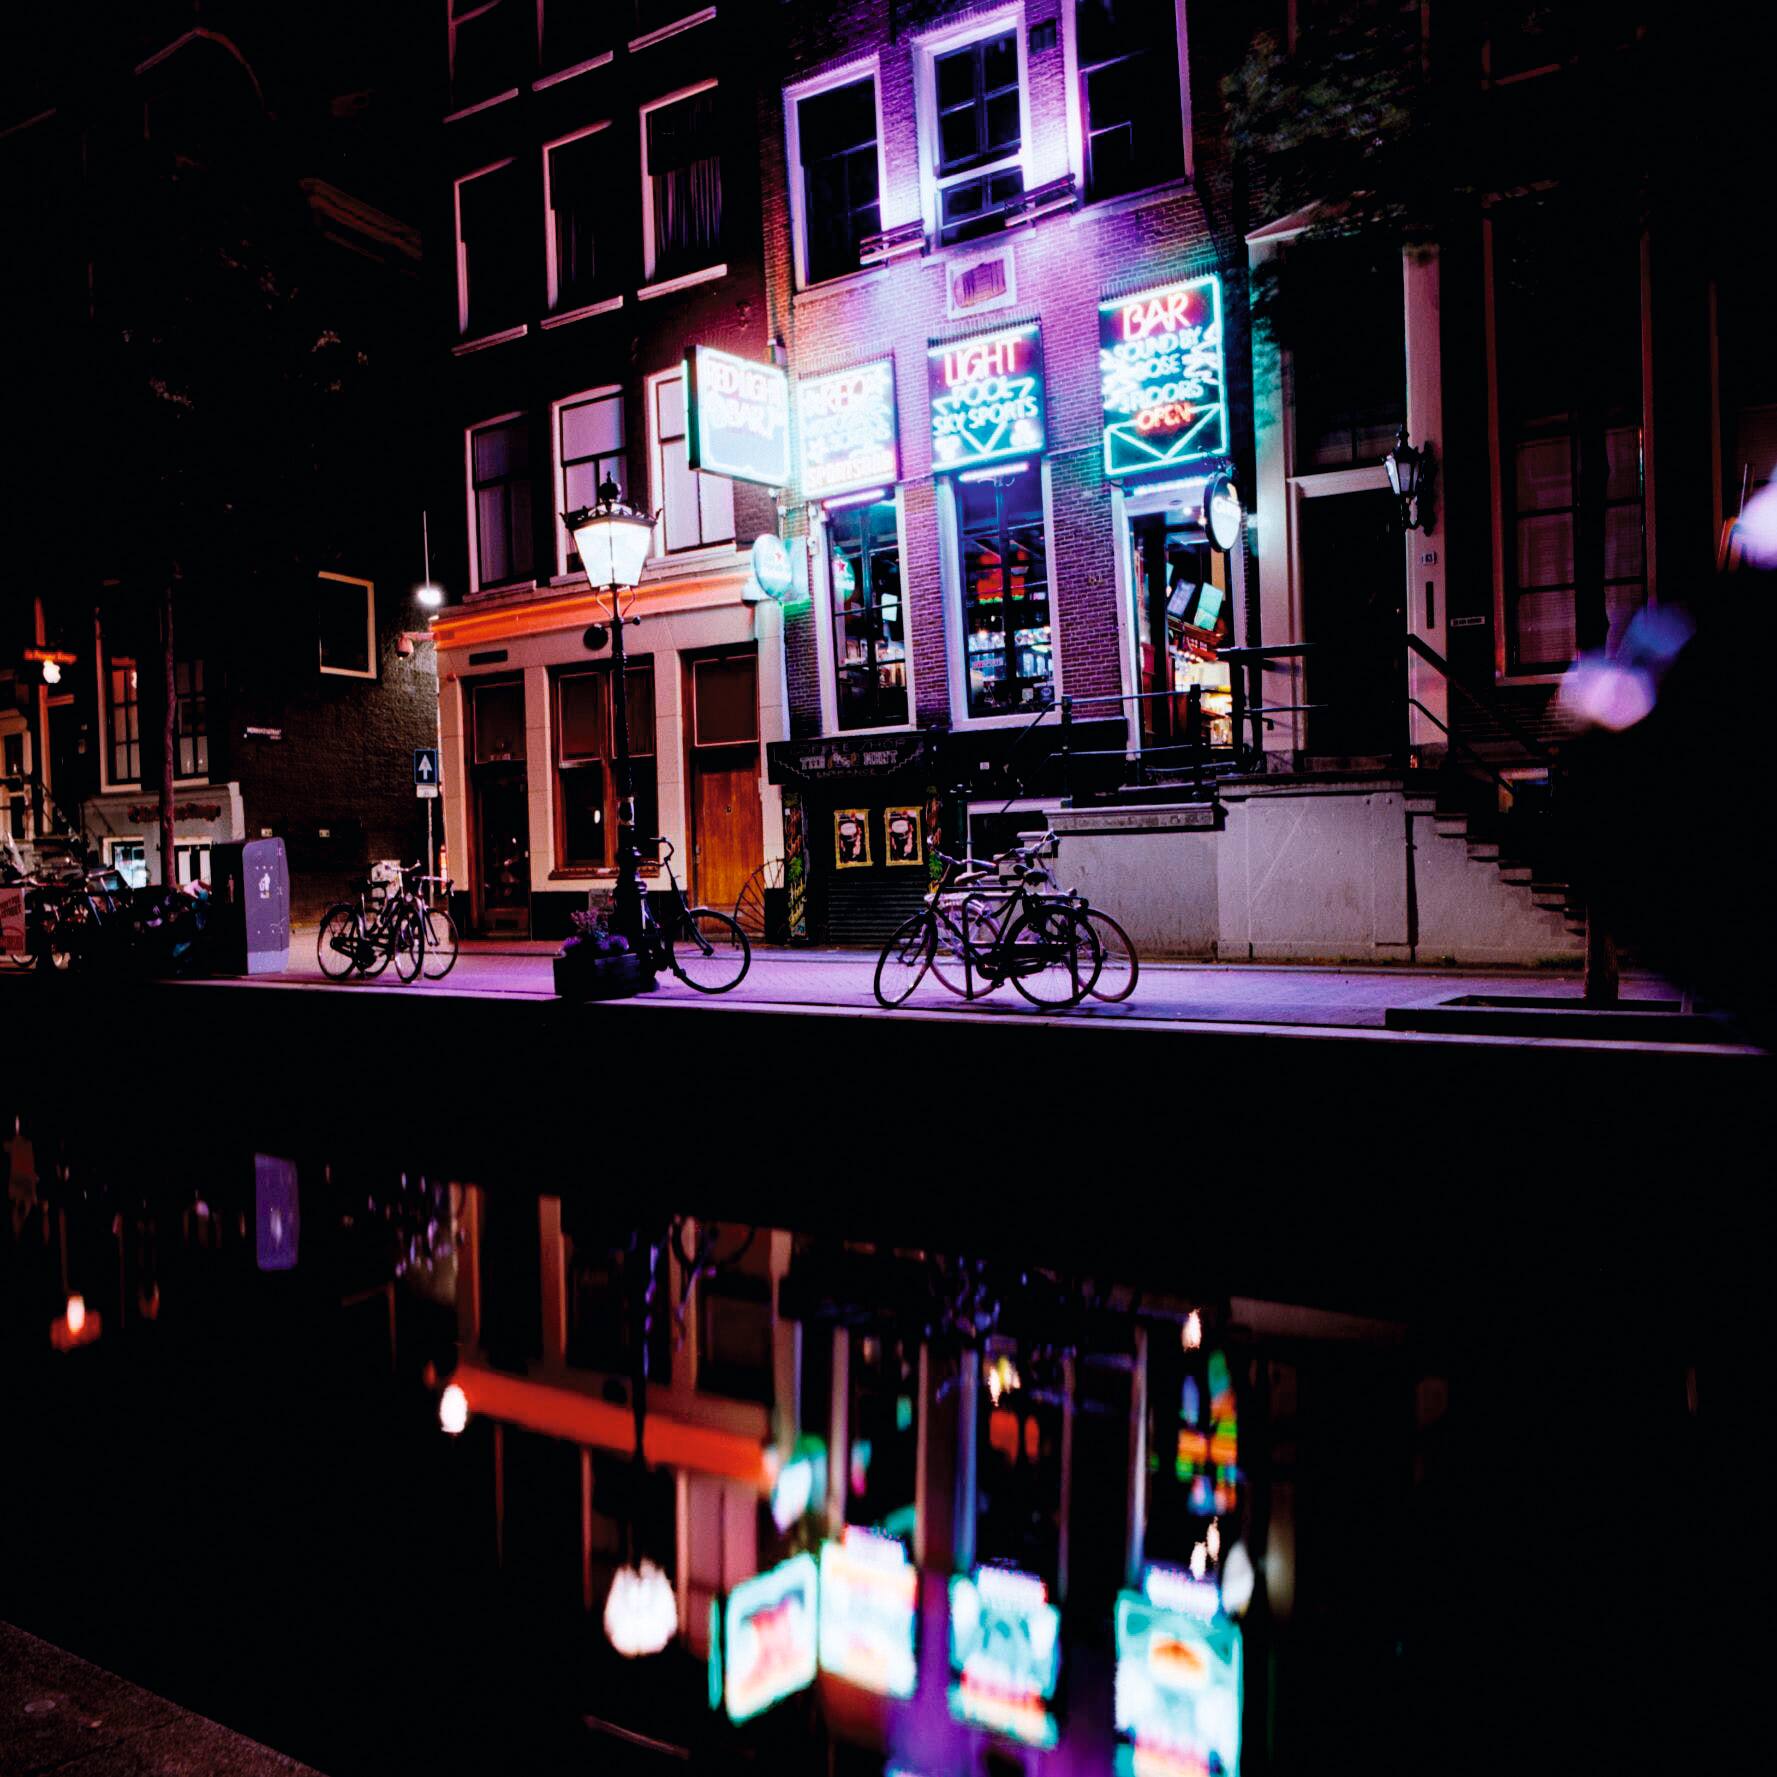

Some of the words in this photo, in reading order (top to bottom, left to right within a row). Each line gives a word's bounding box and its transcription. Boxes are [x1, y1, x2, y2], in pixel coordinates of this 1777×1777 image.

[1122, 294, 1190, 340] BAR
[944, 338, 1022, 385] LIGHT
[1113, 332, 1179, 361] SOUND
[1178, 325, 1203, 350] BY
[951, 375, 1014, 409] POOL
[932, 411, 966, 437] SKY
[968, 396, 1038, 429] SPORTS
[1137, 402, 1194, 430] OPEN
